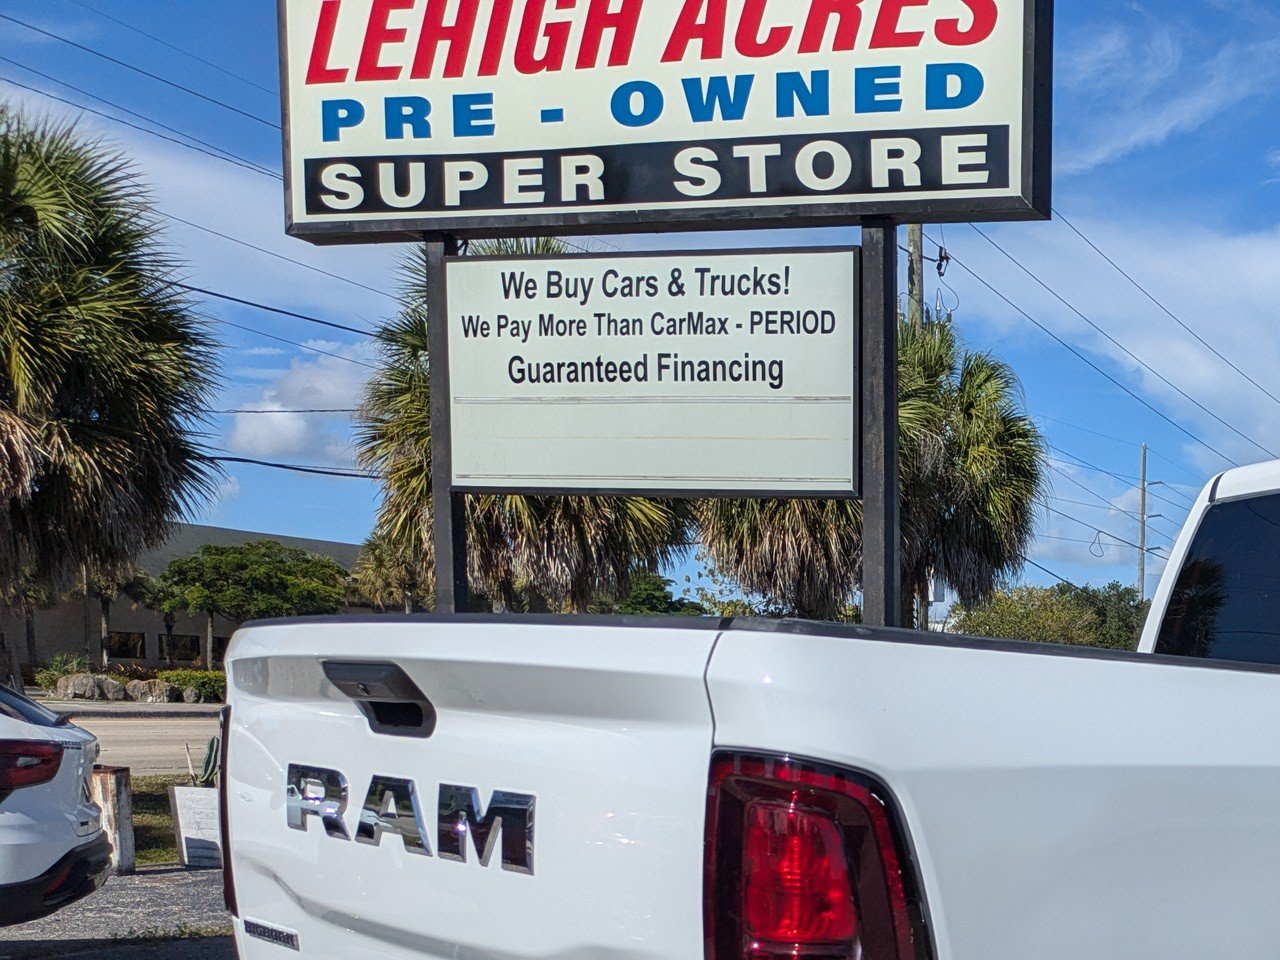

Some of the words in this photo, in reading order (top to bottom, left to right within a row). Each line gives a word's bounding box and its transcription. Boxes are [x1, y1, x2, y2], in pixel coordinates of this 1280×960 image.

[303, 0, 645, 85] LEHIGH
[321, 92, 496, 142] PRE
[610, 62, 985, 128] OWNED
[319, 155, 606, 210] SUPER
[672, 133, 990, 197] STORE
[500, 271, 538, 299] We
[546, 270, 594, 306] Buy
[601, 269, 659, 298] Cars
[667, 267, 686, 297] &
[694, 265, 790, 296] Trucks!
[461, 315, 491, 338] We
[497, 314, 532, 344] Pay
[538, 313, 587, 337] More
[593, 312, 643, 336] Than
[650, 311, 729, 336] CarMax
[750, 310, 836, 335] PERIOD
[507, 353, 648, 384] Guaranteed
[657, 352, 784, 390] Financing
[286, 763, 537, 876] RAM
